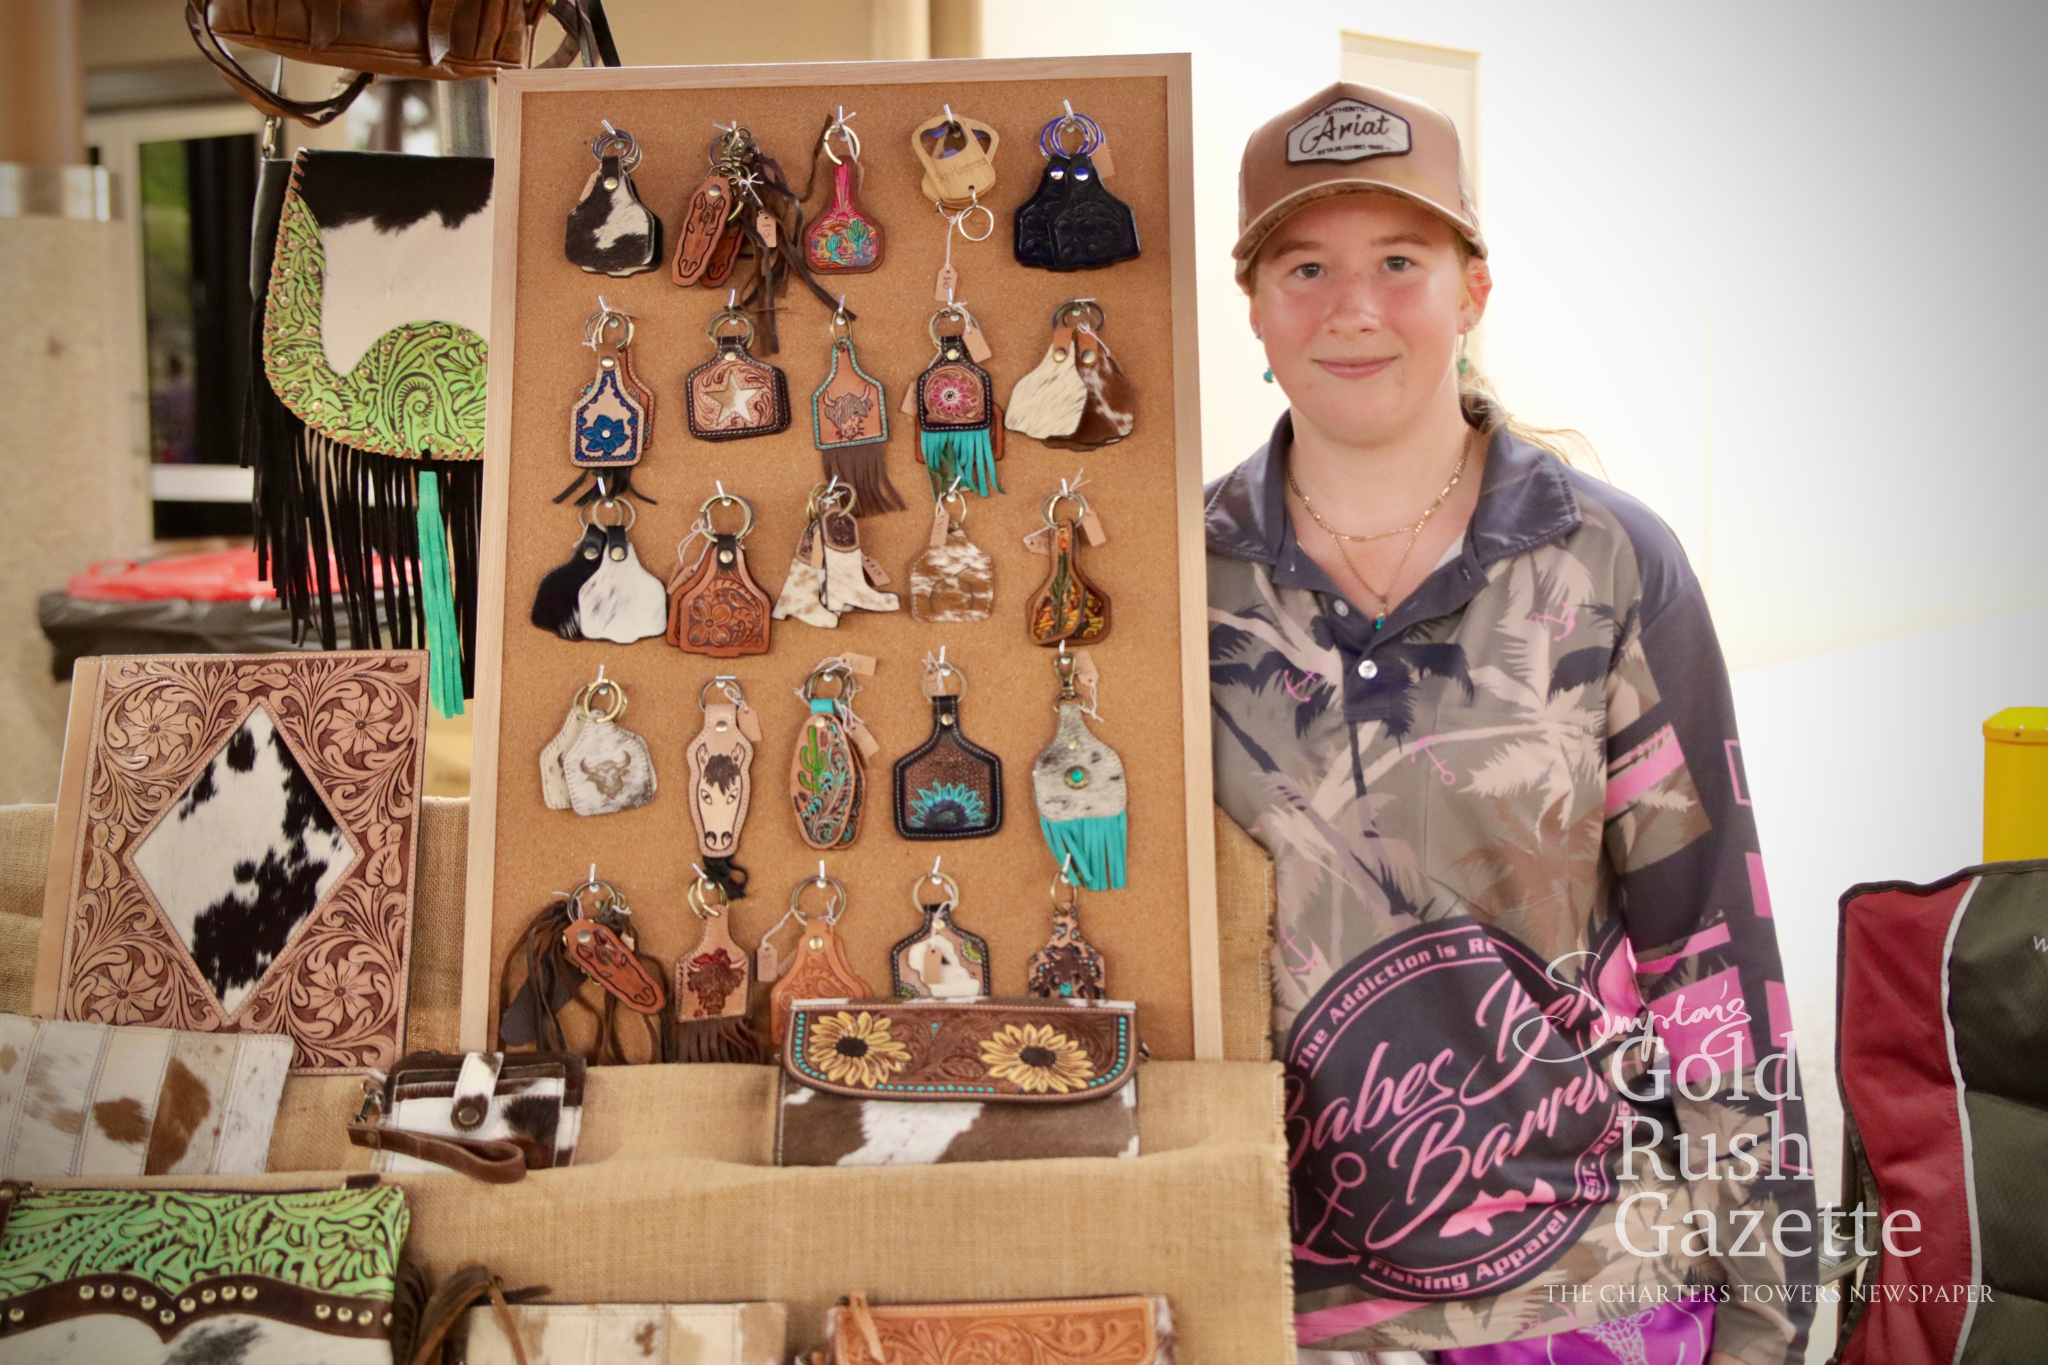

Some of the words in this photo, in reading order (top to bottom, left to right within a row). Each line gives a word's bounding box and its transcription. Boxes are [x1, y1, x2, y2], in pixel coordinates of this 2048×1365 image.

[1300, 114, 1390, 154] Ariat
[1296, 1029, 1329, 1069] The
[1329, 949, 1432, 1025] Addiction
[1436, 943, 1458, 959] is
[1581, 1162, 1601, 1202] EST.
[1368, 1258, 1470, 1291] Fishing
[1475, 1209, 1569, 1281] Apparel
